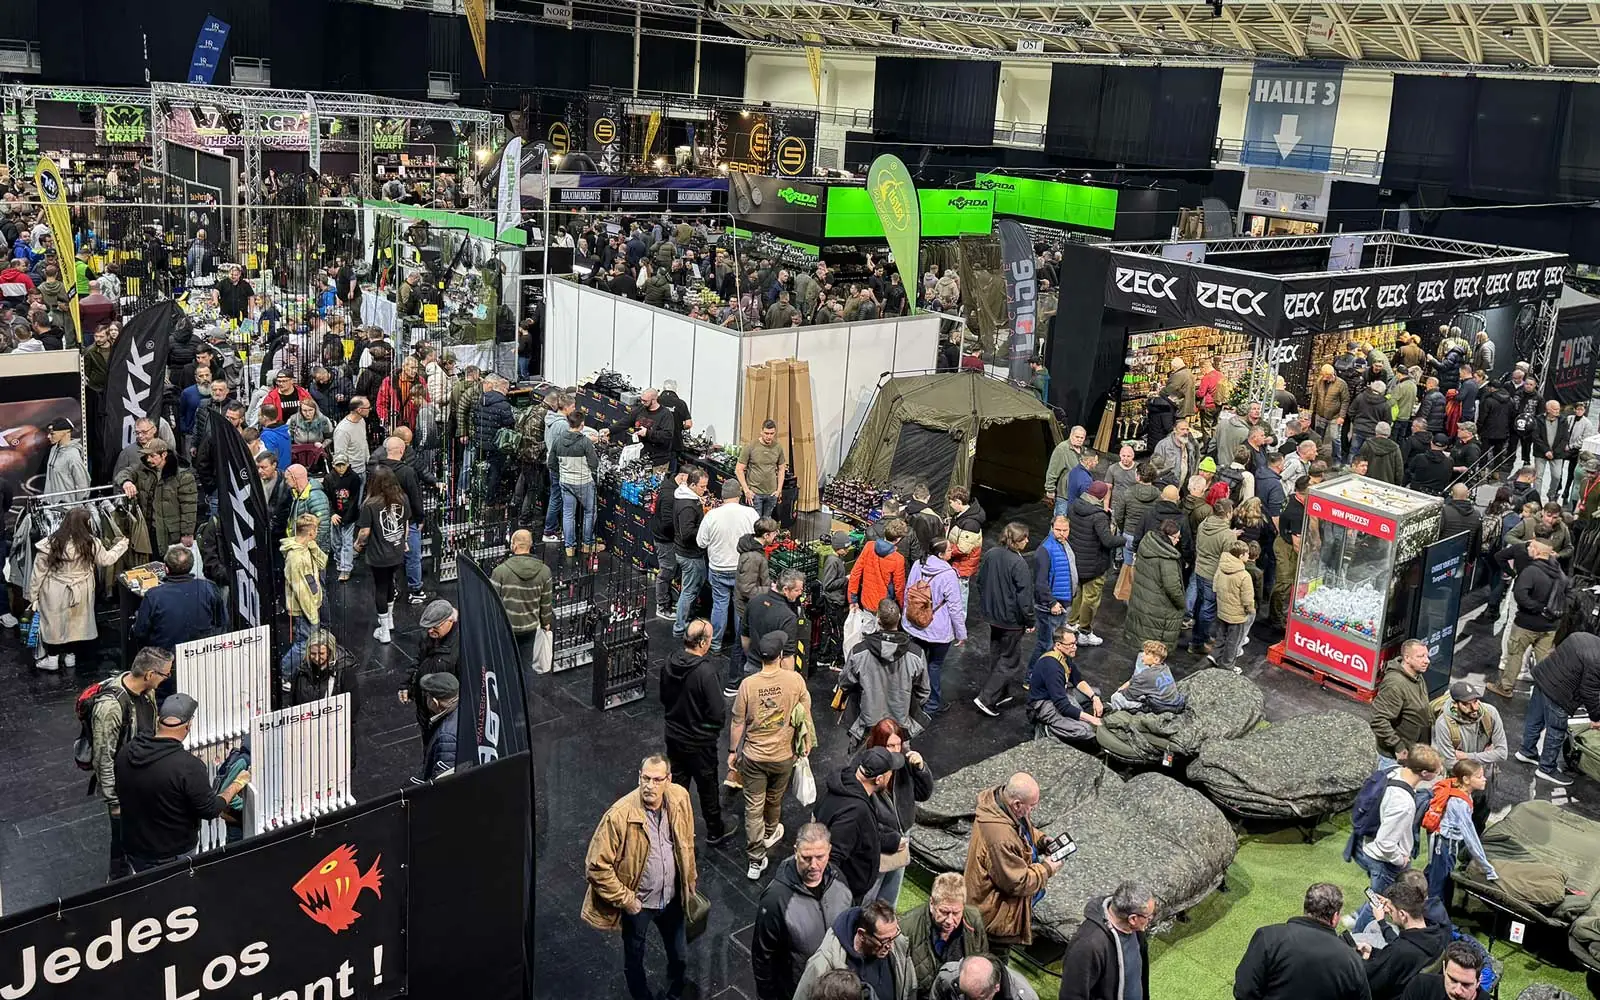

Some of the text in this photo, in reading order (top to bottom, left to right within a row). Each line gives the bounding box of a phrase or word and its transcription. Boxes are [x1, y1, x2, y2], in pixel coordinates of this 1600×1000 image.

[546, 7, 571, 17] NORD
[1022, 40, 1038, 49] OST
[1255, 80, 1336, 106] HALLE 3
[105, 125, 145, 136] WATER
[106, 134, 145, 142] CRAFT
[205, 136, 226, 145] THE
[263, 136, 280, 146] OF
[373, 135, 403, 143] WATER
[374, 142, 402, 150] CRAFT
[561, 190, 601, 200] MAXIMUMBAITS
[621, 191, 659, 201] MAXIMUMBAITS
[778, 187, 818, 204] KORDA
[980, 179, 1015, 191] KORDA
[677, 192, 712, 202] MAXIMUMBAITS
[948, 197, 988, 209] KORDA
[1115, 267, 1179, 300] ZECK
[1485, 273, 1513, 295] ZECK
[1516, 269, 1541, 291] ZECK
[1544, 266, 1566, 286] ZECK
[1196, 281, 1268, 316] ZECK
[1377, 283, 1411, 309] ZECK
[1417, 279, 1448, 304] ZECK
[1453, 276, 1482, 299] ZECK
[1284, 291, 1325, 320] ZECK
[1332, 286, 1371, 313] ZECK
[1331, 507, 1370, 527] WIN PRIZES!
[228, 460, 261, 628] BKK
[184, 635, 263, 657] bullseye
[1294, 631, 1351, 664] trakker
[259, 704, 343, 731] bullseye
[0, 905, 199, 1000] Jedes
[164, 941, 270, 1000] Los
[373, 944, 383, 986] !
